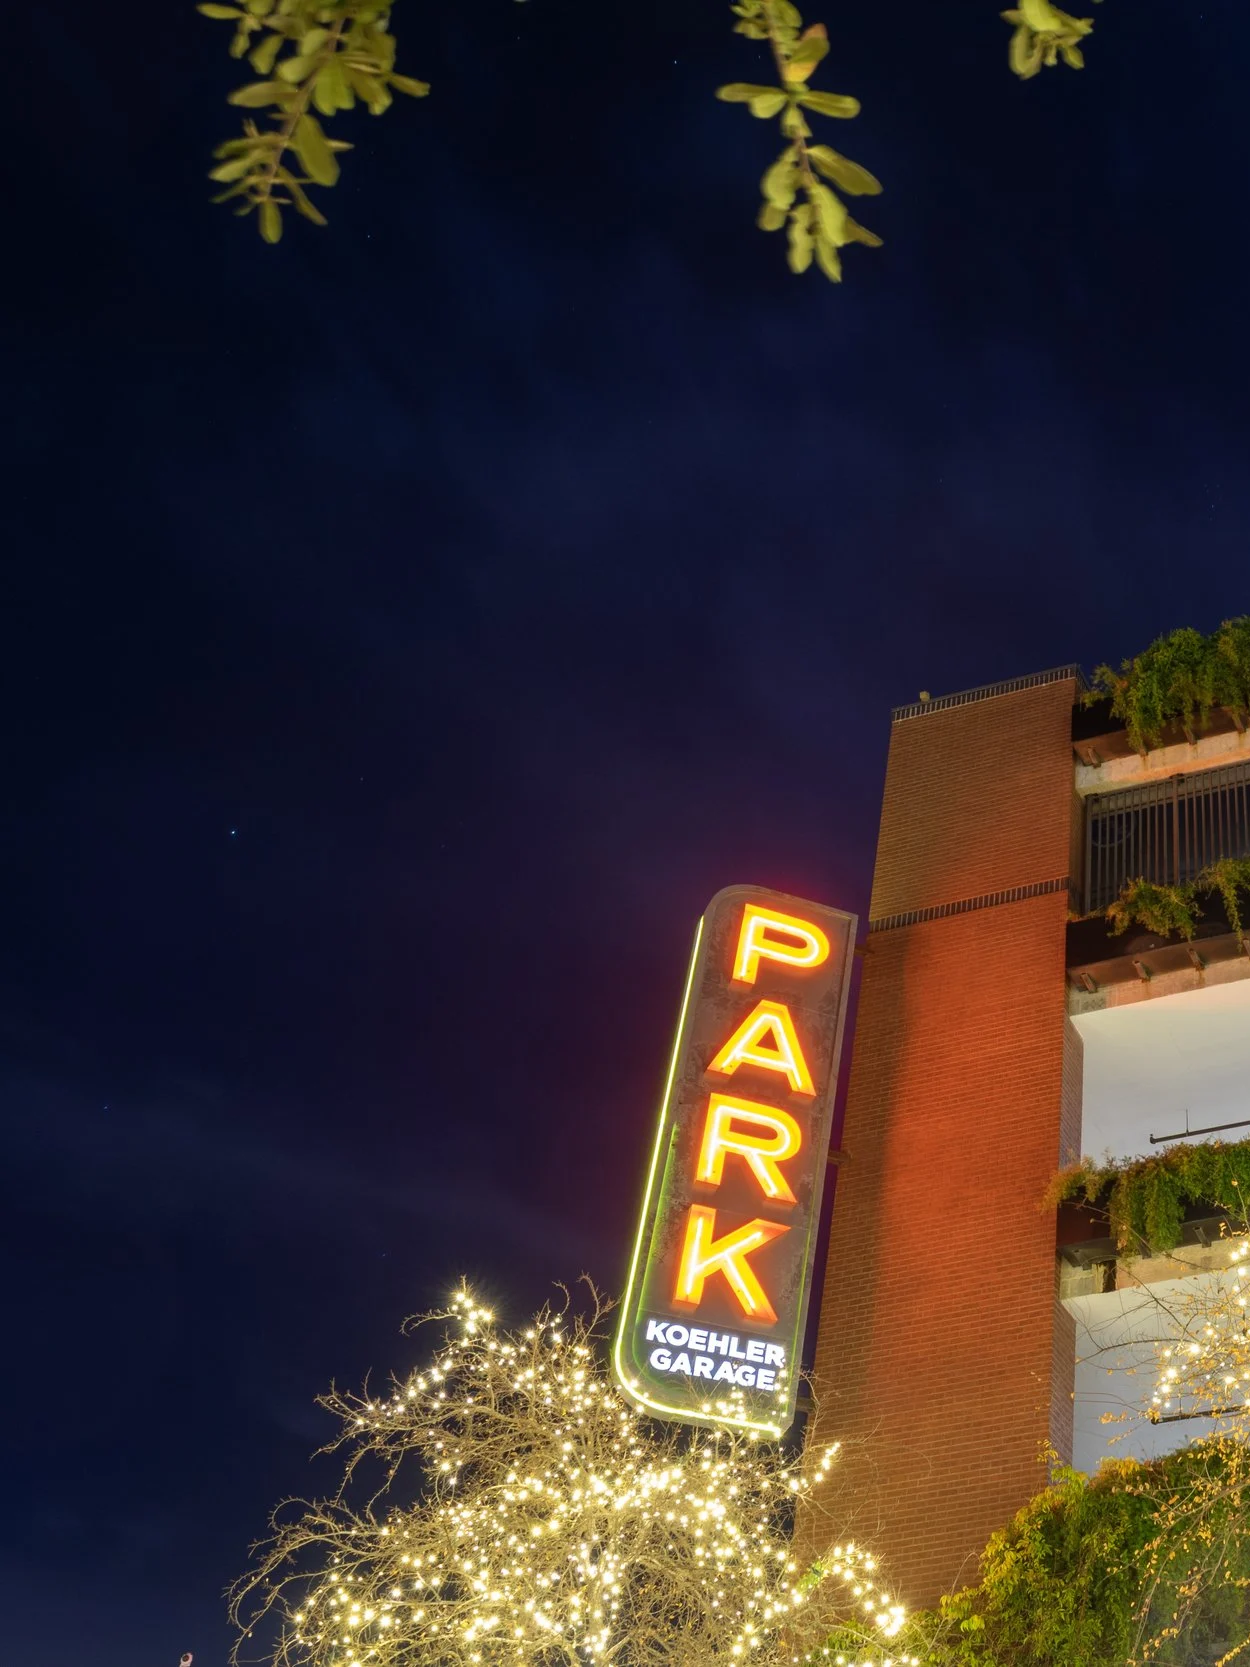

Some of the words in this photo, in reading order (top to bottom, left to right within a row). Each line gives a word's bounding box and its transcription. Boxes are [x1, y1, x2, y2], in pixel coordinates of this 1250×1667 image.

[673, 903, 830, 1322] PARK
[645, 1319, 785, 1368] KOEHLER
[650, 1348, 776, 1391] GARAGE
